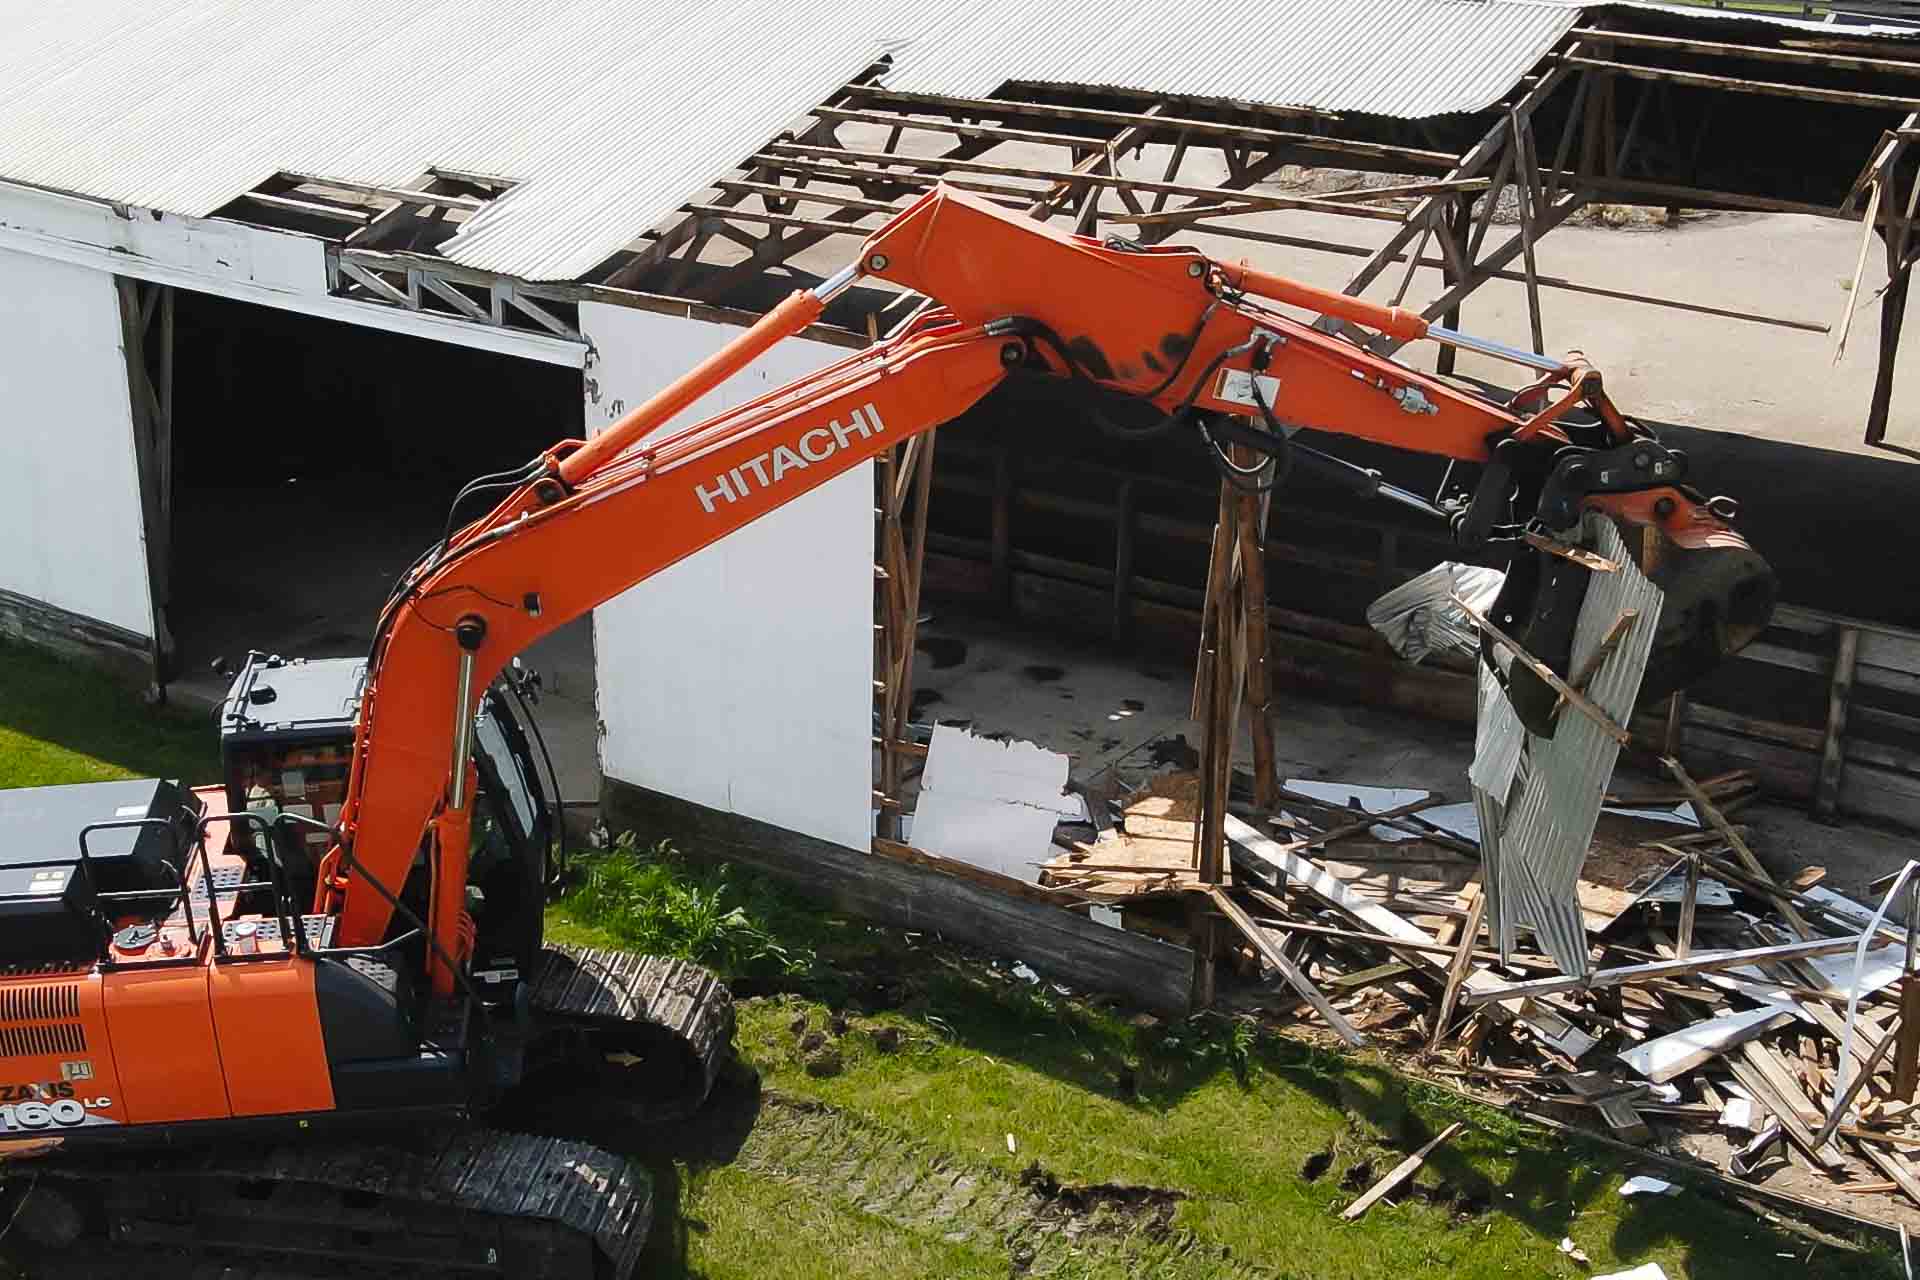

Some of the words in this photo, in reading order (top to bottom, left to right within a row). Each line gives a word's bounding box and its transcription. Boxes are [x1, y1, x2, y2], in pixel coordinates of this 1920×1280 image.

[694, 402, 885, 512] HITACHI
[0, 1100, 85, 1130] 160
[83, 1096, 112, 1109] LC
